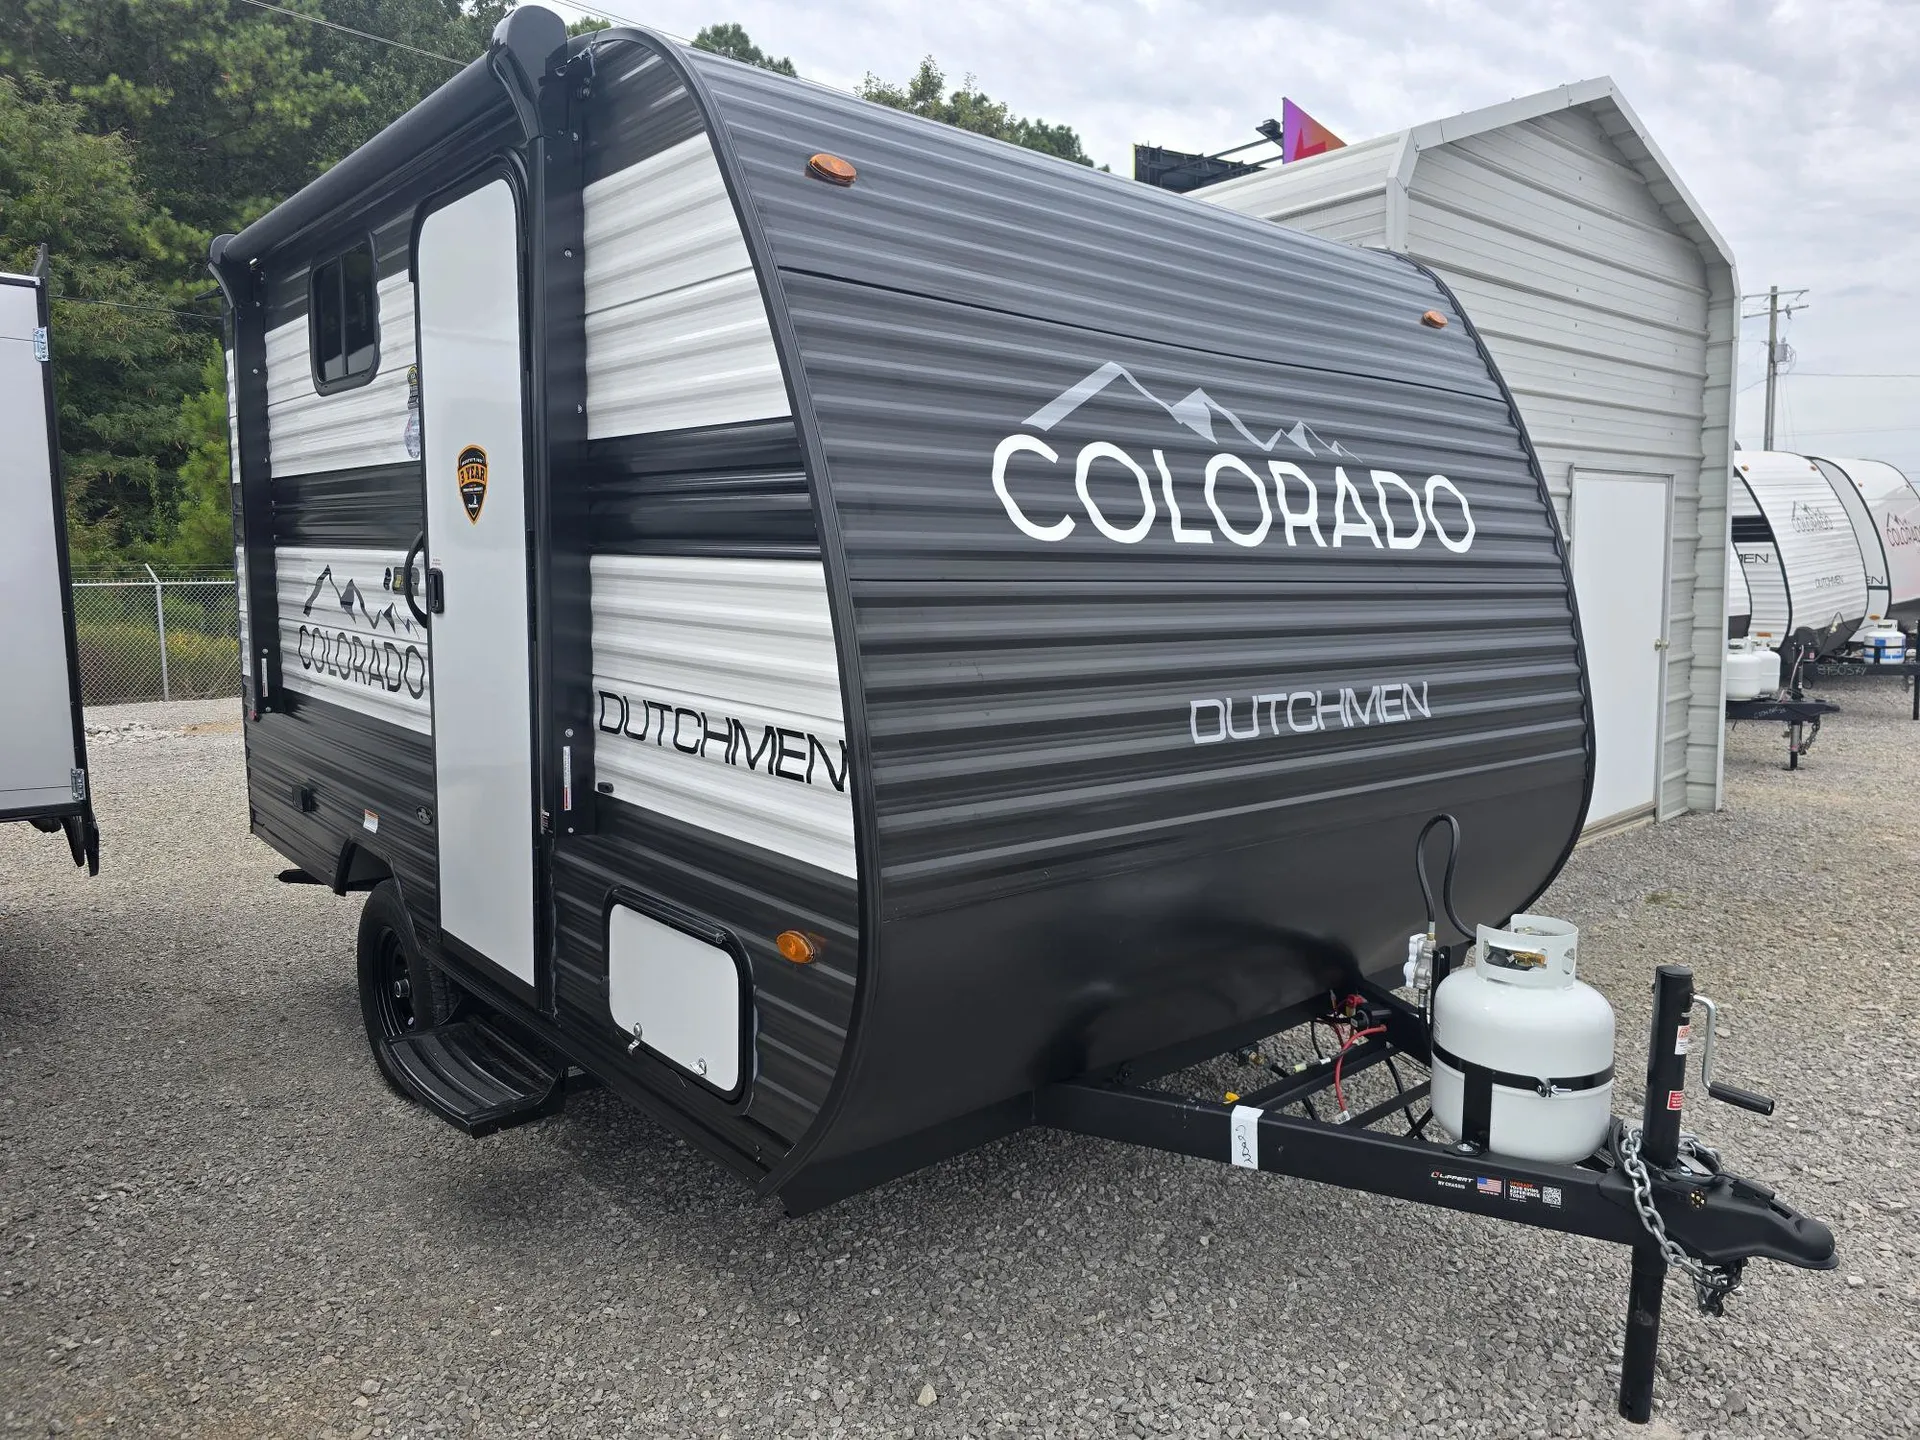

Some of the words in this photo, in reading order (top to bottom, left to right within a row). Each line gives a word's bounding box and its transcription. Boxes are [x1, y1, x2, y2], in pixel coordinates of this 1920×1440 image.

[460, 470, 465, 485] 3
[466, 465, 485, 482] YEAR
[991, 433, 1477, 554] COLORADO
[1886, 525, 1920, 547] COLORAD
[298, 624, 426, 700] COLORADO
[599, 690, 850, 792] DUTCHMEN
[1189, 681, 1432, 745] DUTCHMEN
